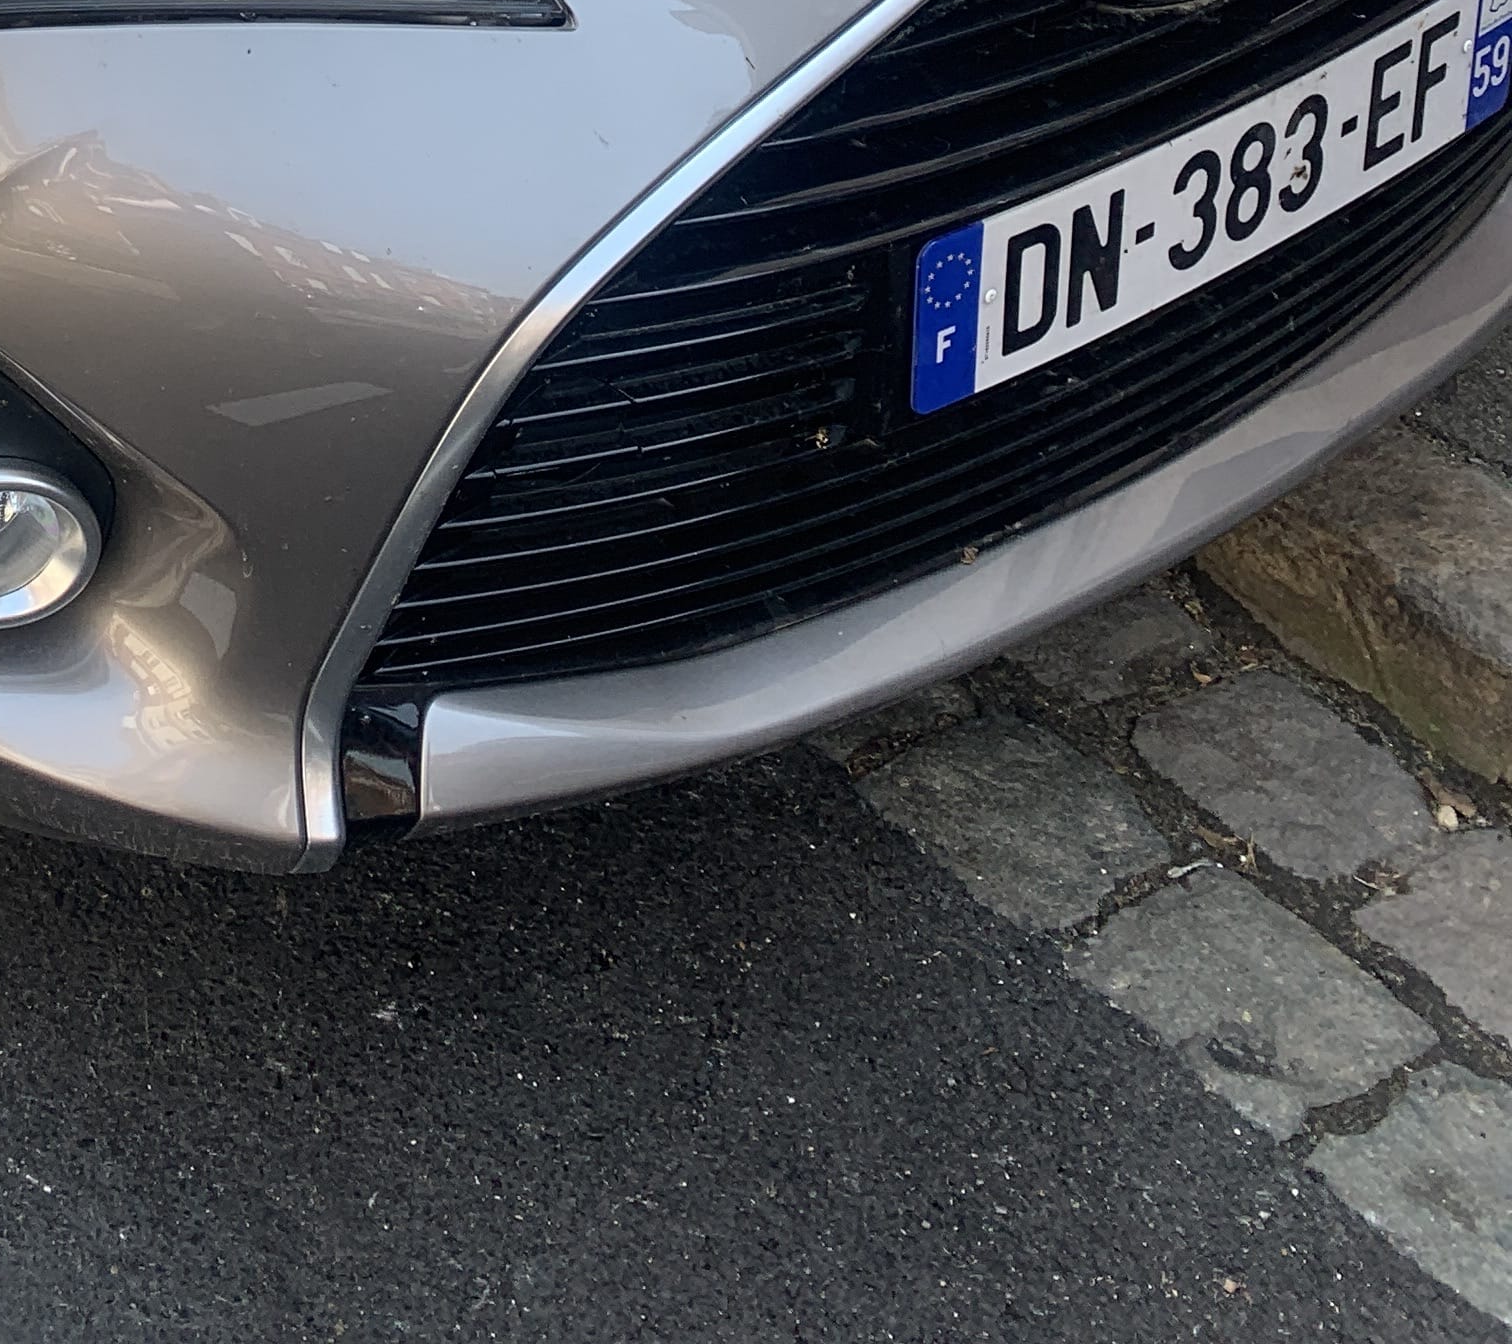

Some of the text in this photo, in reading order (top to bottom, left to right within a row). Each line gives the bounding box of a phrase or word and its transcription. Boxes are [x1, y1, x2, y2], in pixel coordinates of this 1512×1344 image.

[1472, 35, 1510, 98] 59
[1001, 11, 1461, 357] DN-383-EF
[935, 325, 956, 363] F
